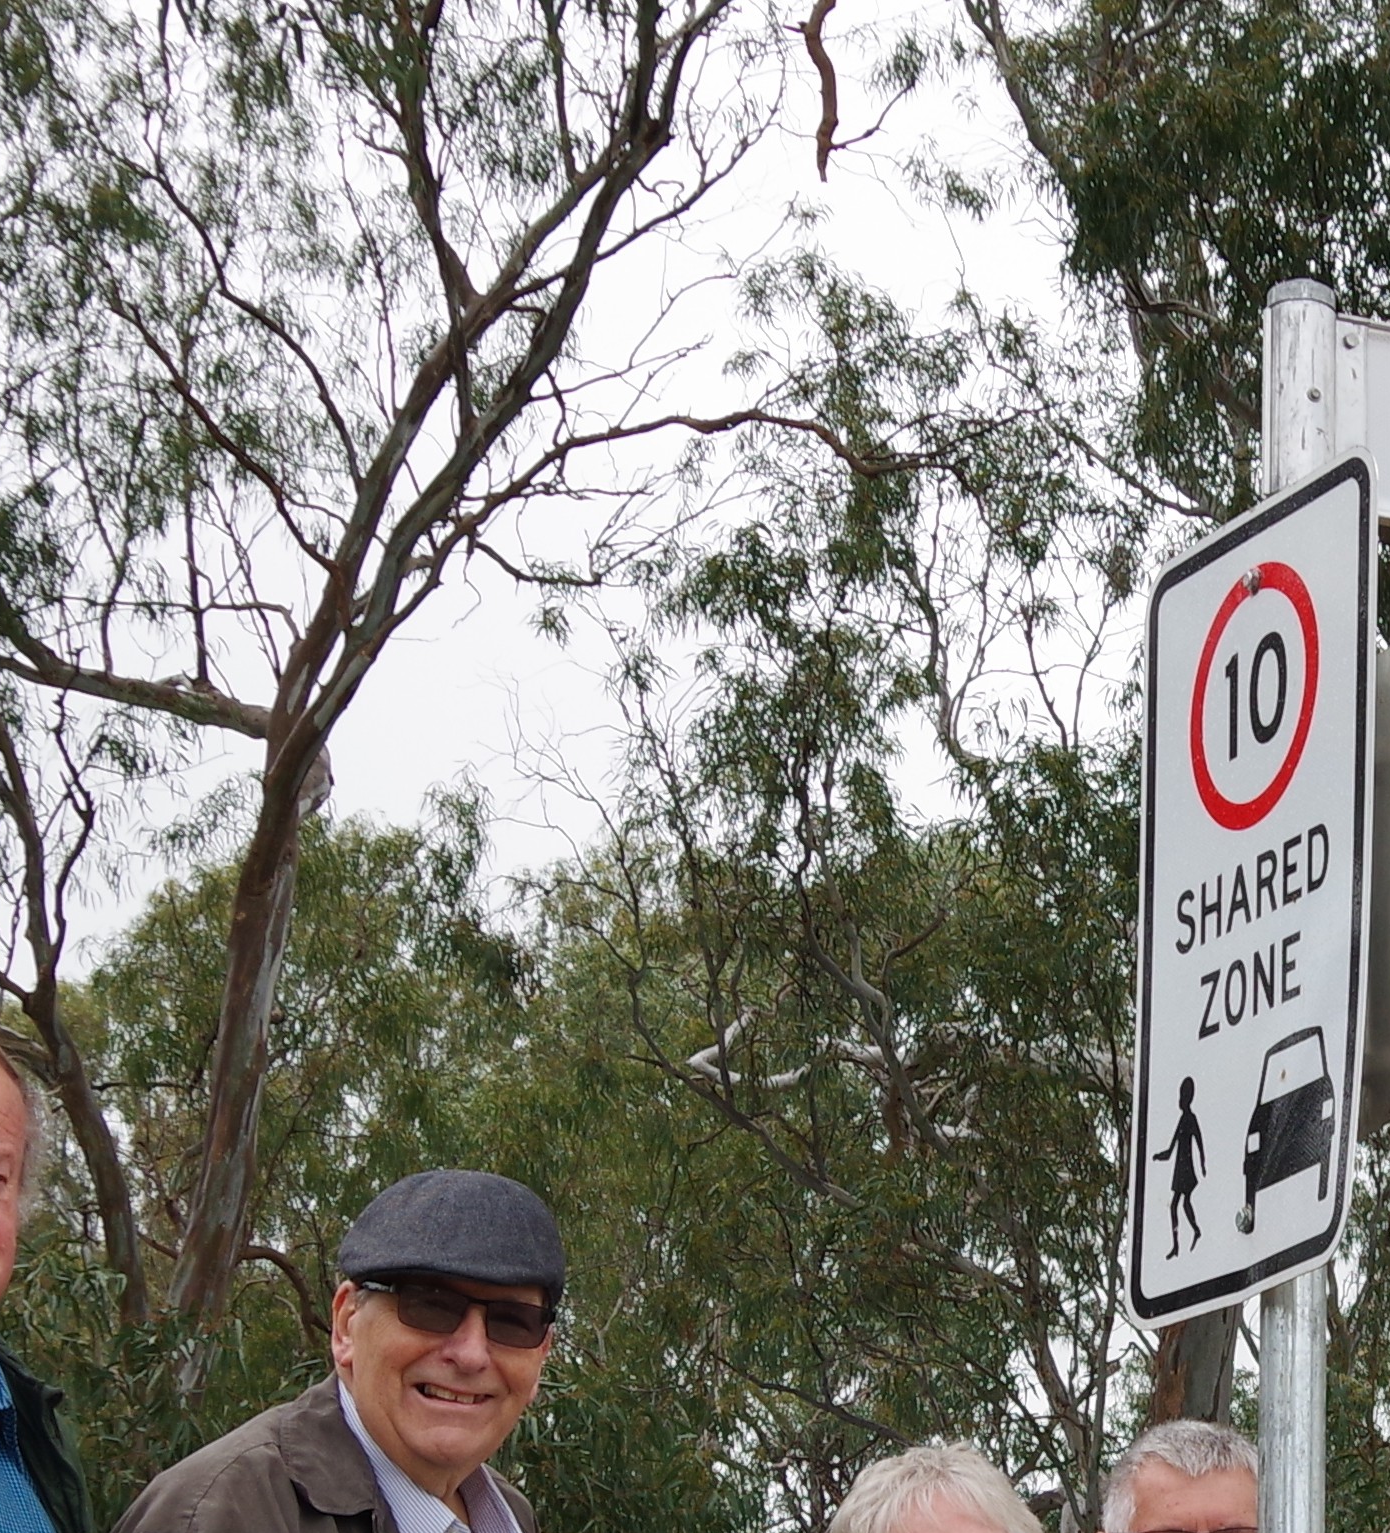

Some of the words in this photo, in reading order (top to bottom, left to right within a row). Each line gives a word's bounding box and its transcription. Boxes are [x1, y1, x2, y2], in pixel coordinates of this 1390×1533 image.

[1224, 631, 1289, 763] 10
[1175, 823, 1330, 956] SHARED
[1198, 931, 1302, 1041] ZONE
